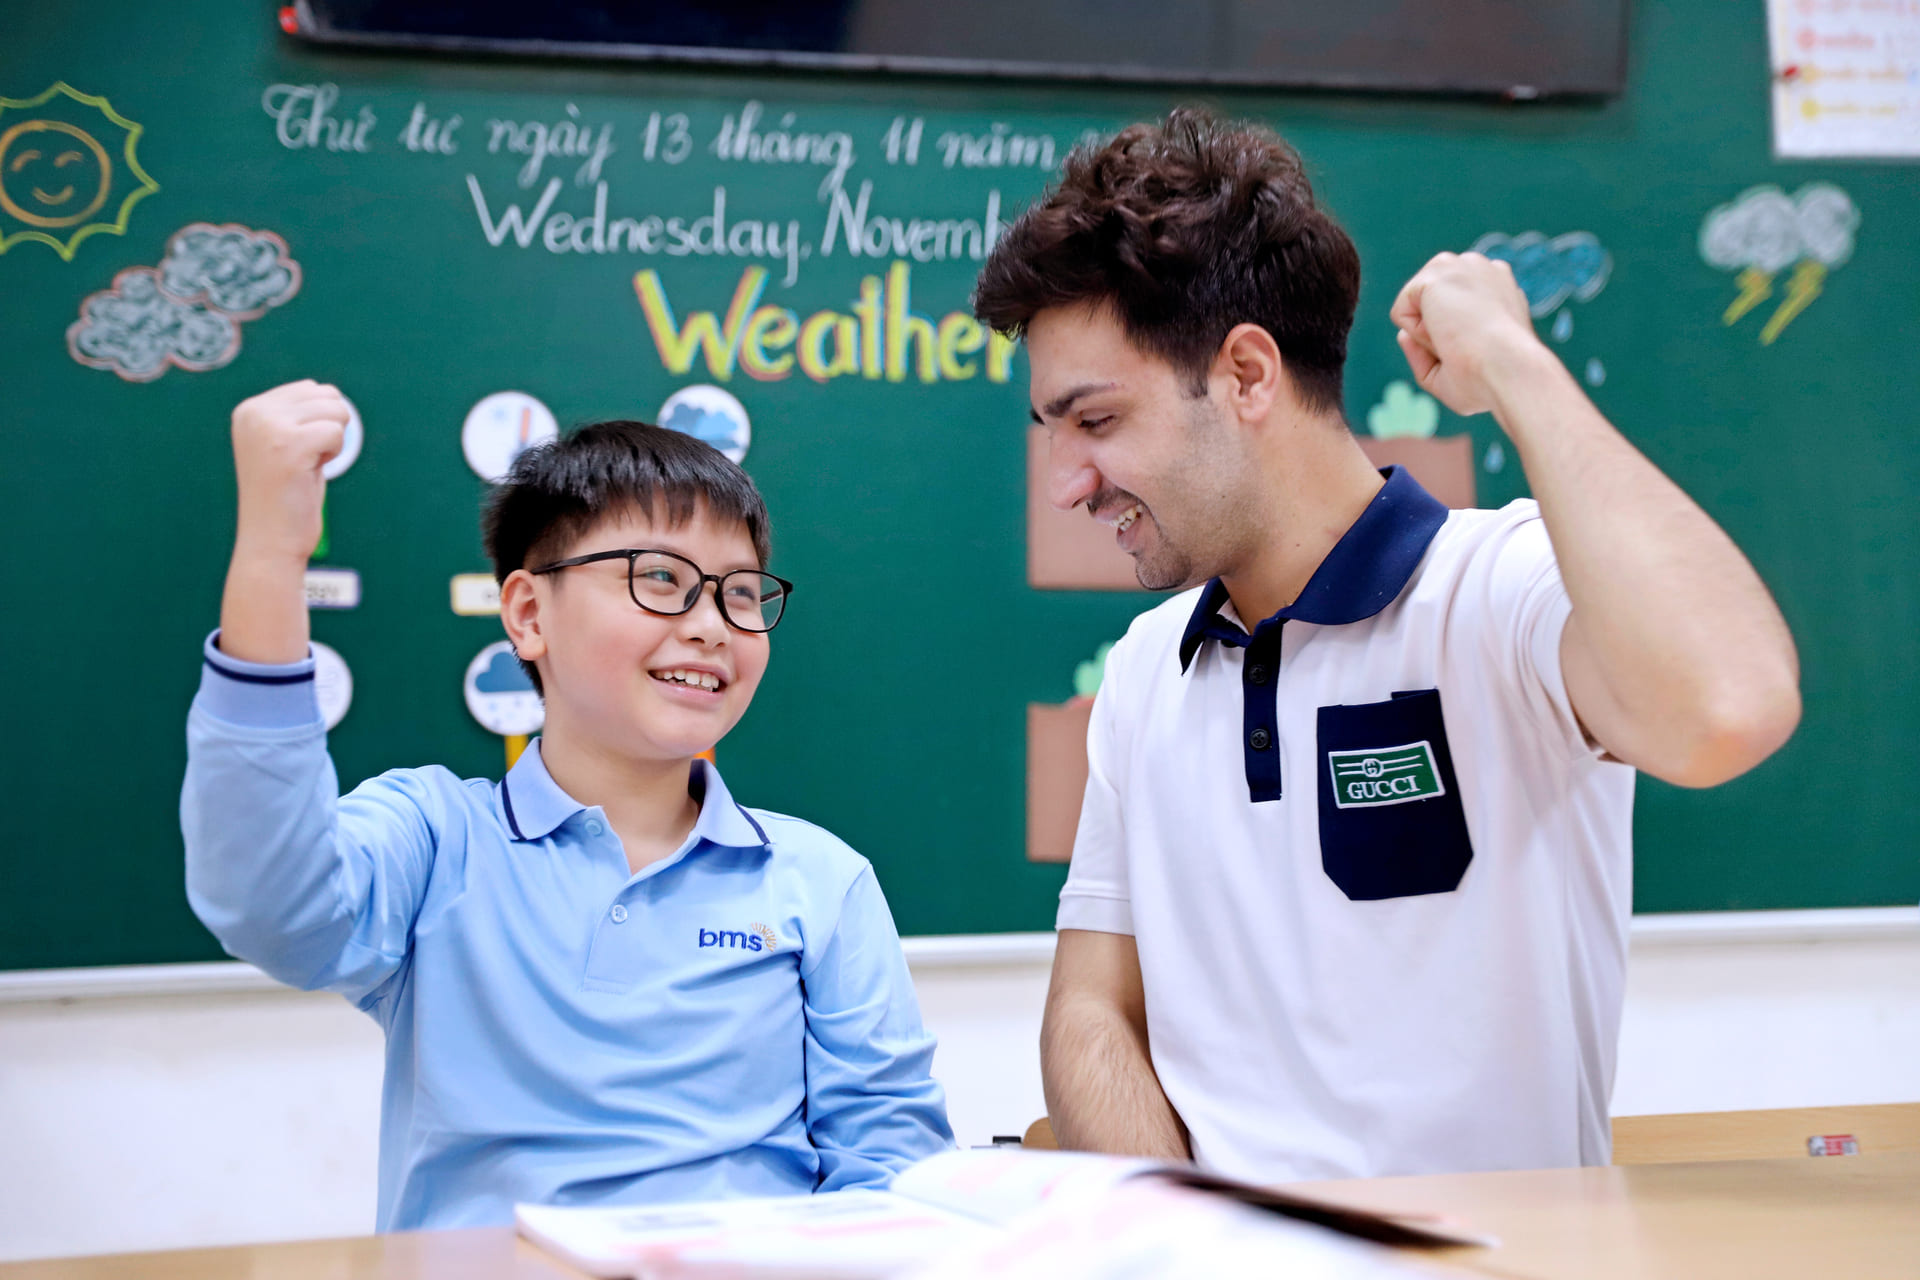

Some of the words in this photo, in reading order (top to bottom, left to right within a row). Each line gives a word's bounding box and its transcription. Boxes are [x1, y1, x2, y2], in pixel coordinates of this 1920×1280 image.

[485, 103, 616, 190] ngày
[641, 111, 693, 165] 13
[708, 100, 856, 203] tháng
[880, 115, 925, 166] 11
[935, 122, 1056, 171] năm
[465, 172, 812, 289] Wednesday,
[632, 260, 1018, 384] Weather
[1346, 775, 1421, 799] GUCCI
[698, 928, 763, 952] bms
